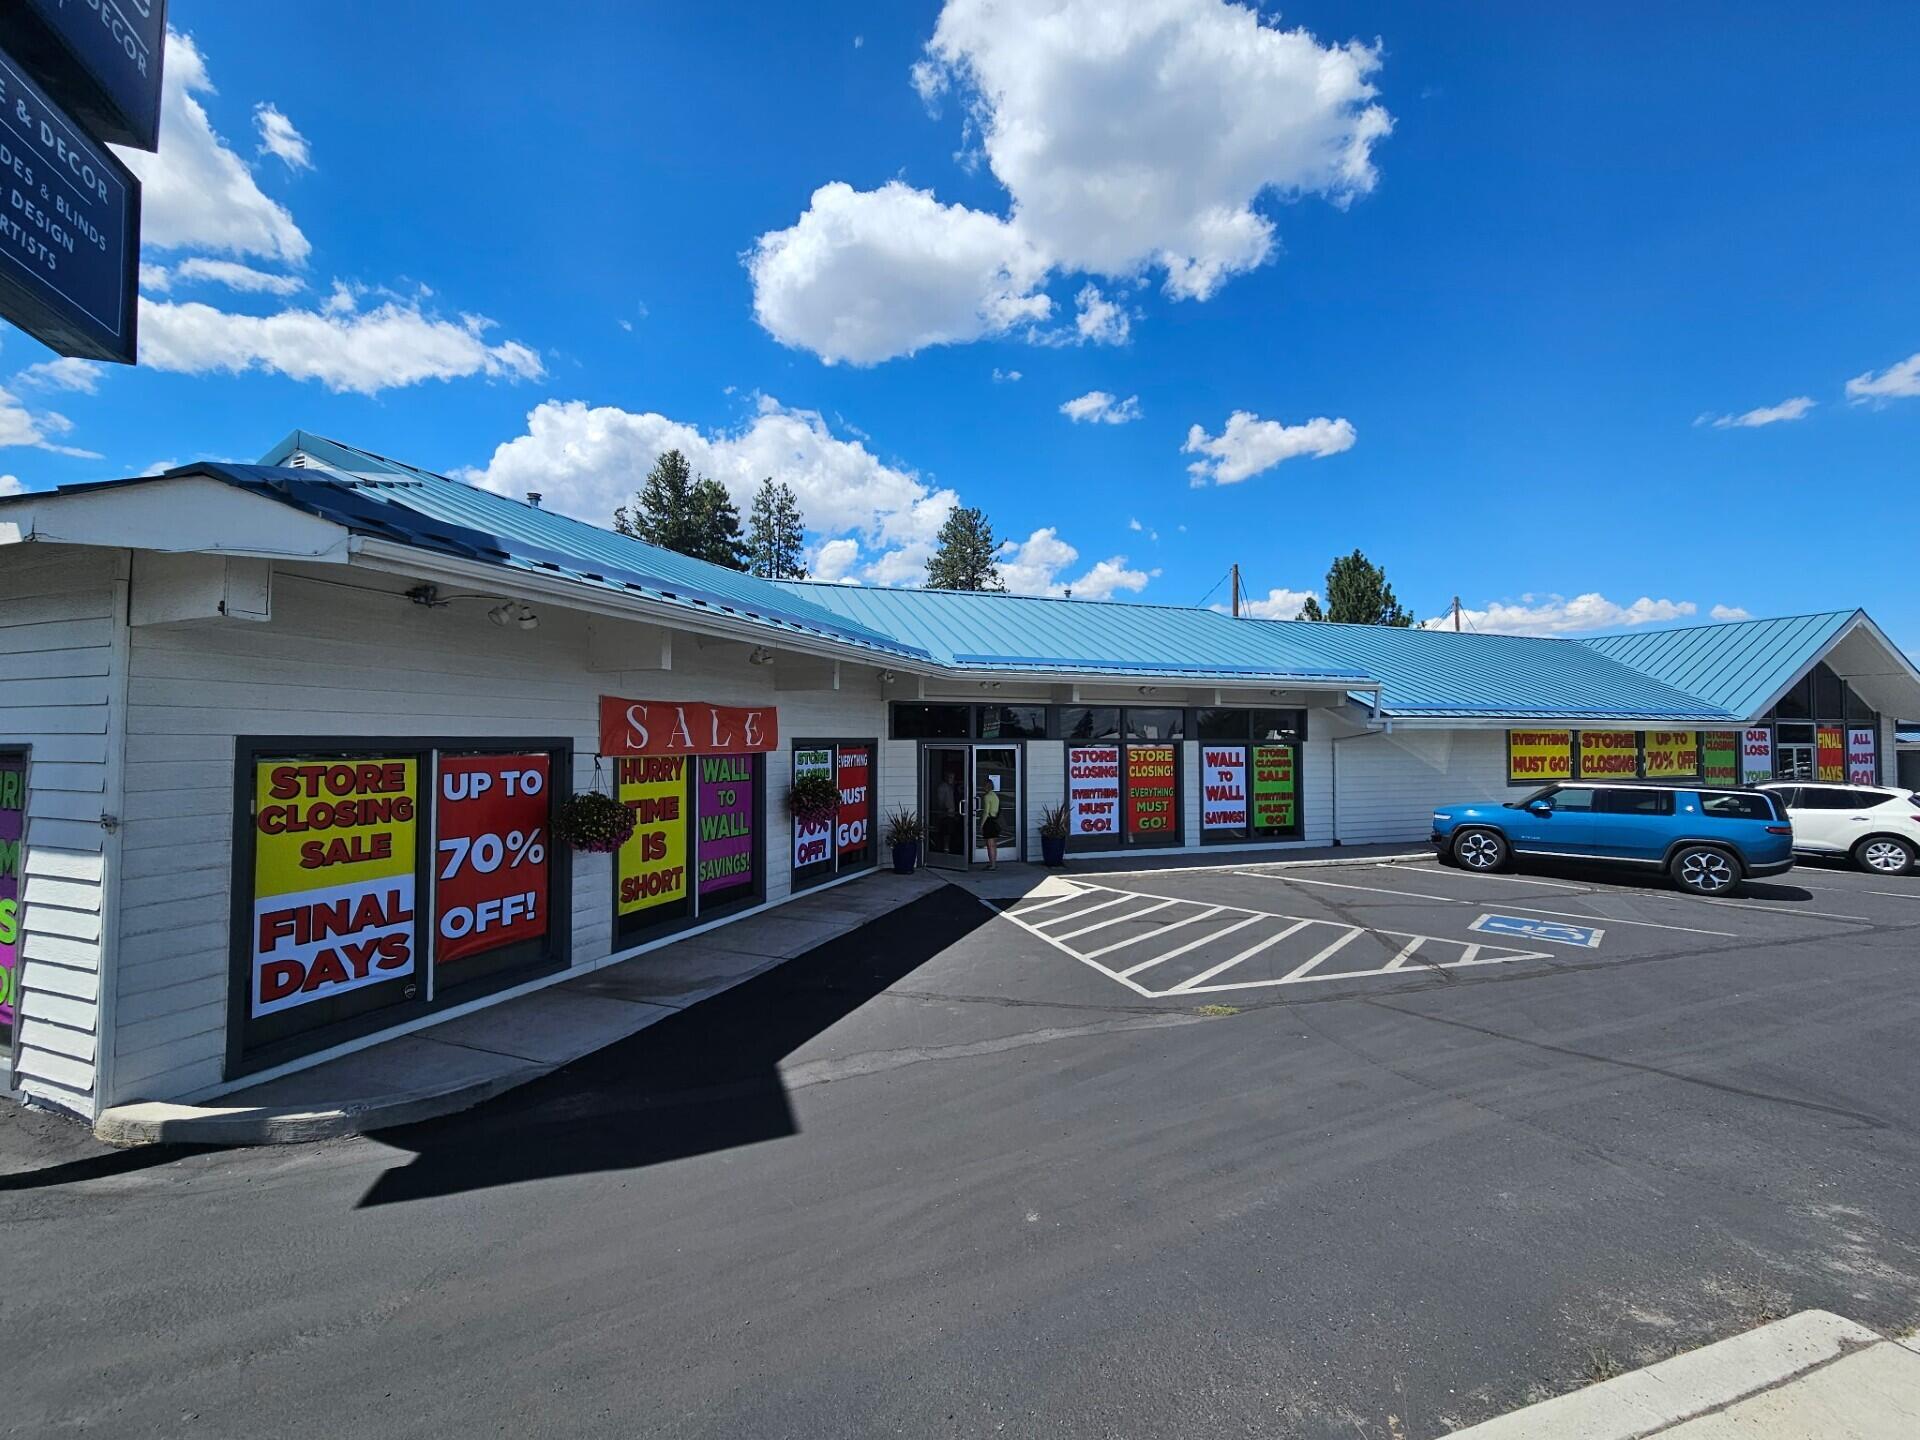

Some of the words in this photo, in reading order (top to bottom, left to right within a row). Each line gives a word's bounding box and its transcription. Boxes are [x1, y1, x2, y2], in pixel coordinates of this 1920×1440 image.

[17, 99, 32, 129] &
[41, 121, 109, 205] DECOR
[12, 189, 74, 253] DESIGN
[40, 183, 49, 200] &
[56, 195, 106, 251] BLINDS
[626, 704, 764, 749] SALE
[1512, 733, 1569, 746] EVERYTHING
[1582, 733, 1635, 748] STORE
[1655, 732, 1672, 746] UP
[1674, 733, 1688, 745] TO
[1746, 730, 1768, 742] OUR
[1817, 733, 1842, 748] FINAL
[1853, 734, 1871, 745] ALL
[797, 751, 829, 765] STORE
[1071, 750, 1117, 763] STORE
[1129, 750, 1173, 762] STORE
[1257, 749, 1288, 758] STORE
[1744, 745, 1770, 756] LOSS
[838, 754, 868, 768] EVERYTHING
[1205, 752, 1244, 768] WALL
[1513, 756, 1547, 773] MUST
[1551, 756, 1570, 773] GO!
[1582, 755, 1636, 773] CLOSING
[1647, 751, 1674, 771] 70%
[1677, 751, 1696, 770] OFF!
[1850, 753, 1874, 765] MUST
[620, 757, 685, 784] HURRY
[702, 757, 750, 783] WALL
[1071, 765, 1118, 779] CLOSING!
[1129, 765, 1174, 777] CLOSING!
[1218, 770, 1233, 782] TO
[1257, 770, 1290, 782] SALE
[1744, 770, 1771, 781] YOUR
[1818, 766, 1844, 782] DAYS
[1852, 770, 1874, 785] GO!
[269, 763, 405, 799] STORE
[443, 772, 491, 800] UP
[500, 770, 543, 796] TO
[718, 790, 736, 807] TO
[840, 786, 867, 805] MUST
[1072, 788, 1118, 799] EVERYTHING
[1130, 787, 1174, 797] EVERYTHING
[1205, 785, 1244, 801] WALL
[624, 796, 679, 825] TIME
[1079, 802, 1114, 815] MUST
[1136, 801, 1169, 812] MUST
[1258, 803, 1291, 814] MUST
[257, 797, 413, 834] CLOSING
[1139, 817, 1167, 829] GO!
[1205, 811, 1245, 824] SAVINGS!
[701, 812, 749, 842] WALL
[838, 819, 868, 847] GO!
[1081, 818, 1111, 832] GO!
[300, 833, 391, 869] SALE
[439, 828, 544, 880] 70%
[641, 831, 667, 862] IS
[798, 839, 827, 864] OFF!
[700, 852, 751, 882] SAVINGS!
[620, 866, 684, 903] SHORT
[259, 890, 413, 953] FINAL
[440, 892, 536, 939] OFF!
[259, 933, 410, 1003] DAYS
